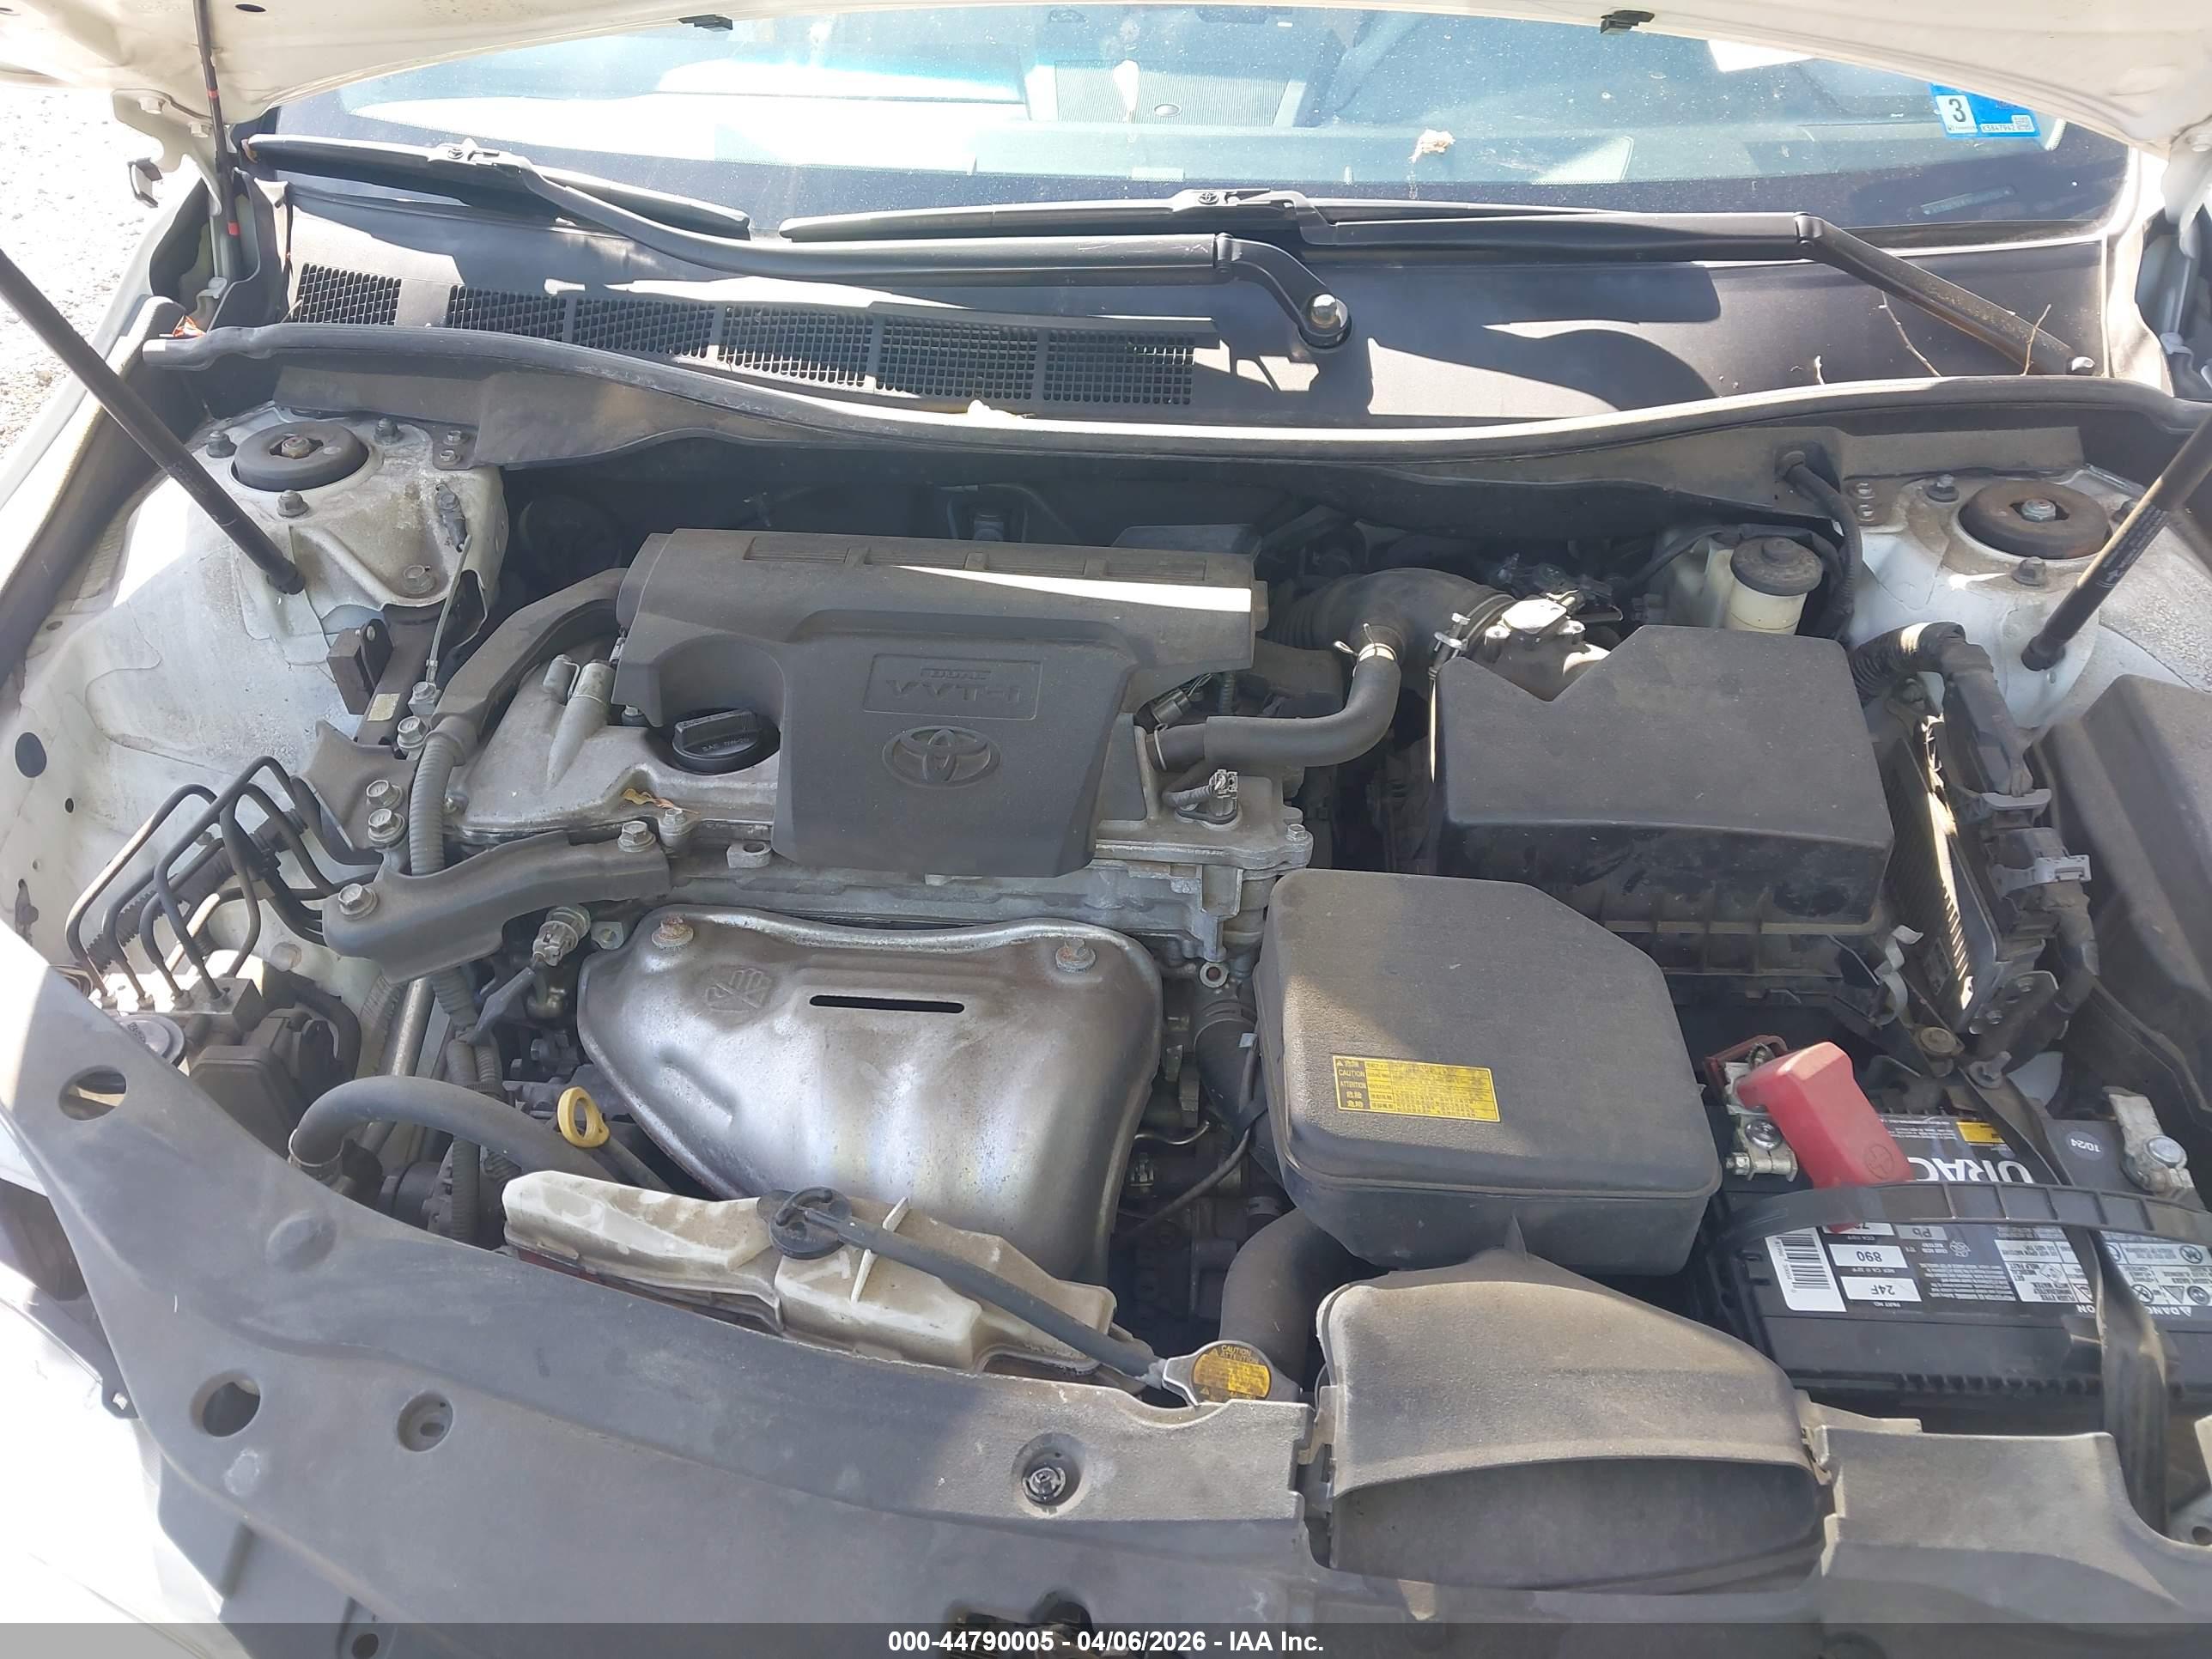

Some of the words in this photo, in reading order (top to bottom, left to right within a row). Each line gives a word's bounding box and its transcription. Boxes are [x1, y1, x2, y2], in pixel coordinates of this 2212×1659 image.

[1948, 98, 1967, 123] 3
[1338, 1069, 1366, 1078] CAUTION
[2070, 1139, 2101, 1152] 10/24
[1911, 1227, 1933, 1238] Pb
[1856, 1250, 1883, 1262] 890
[1870, 1284, 1896, 1296] 24F
[1222, 1345, 1252, 1357] CAUTION
